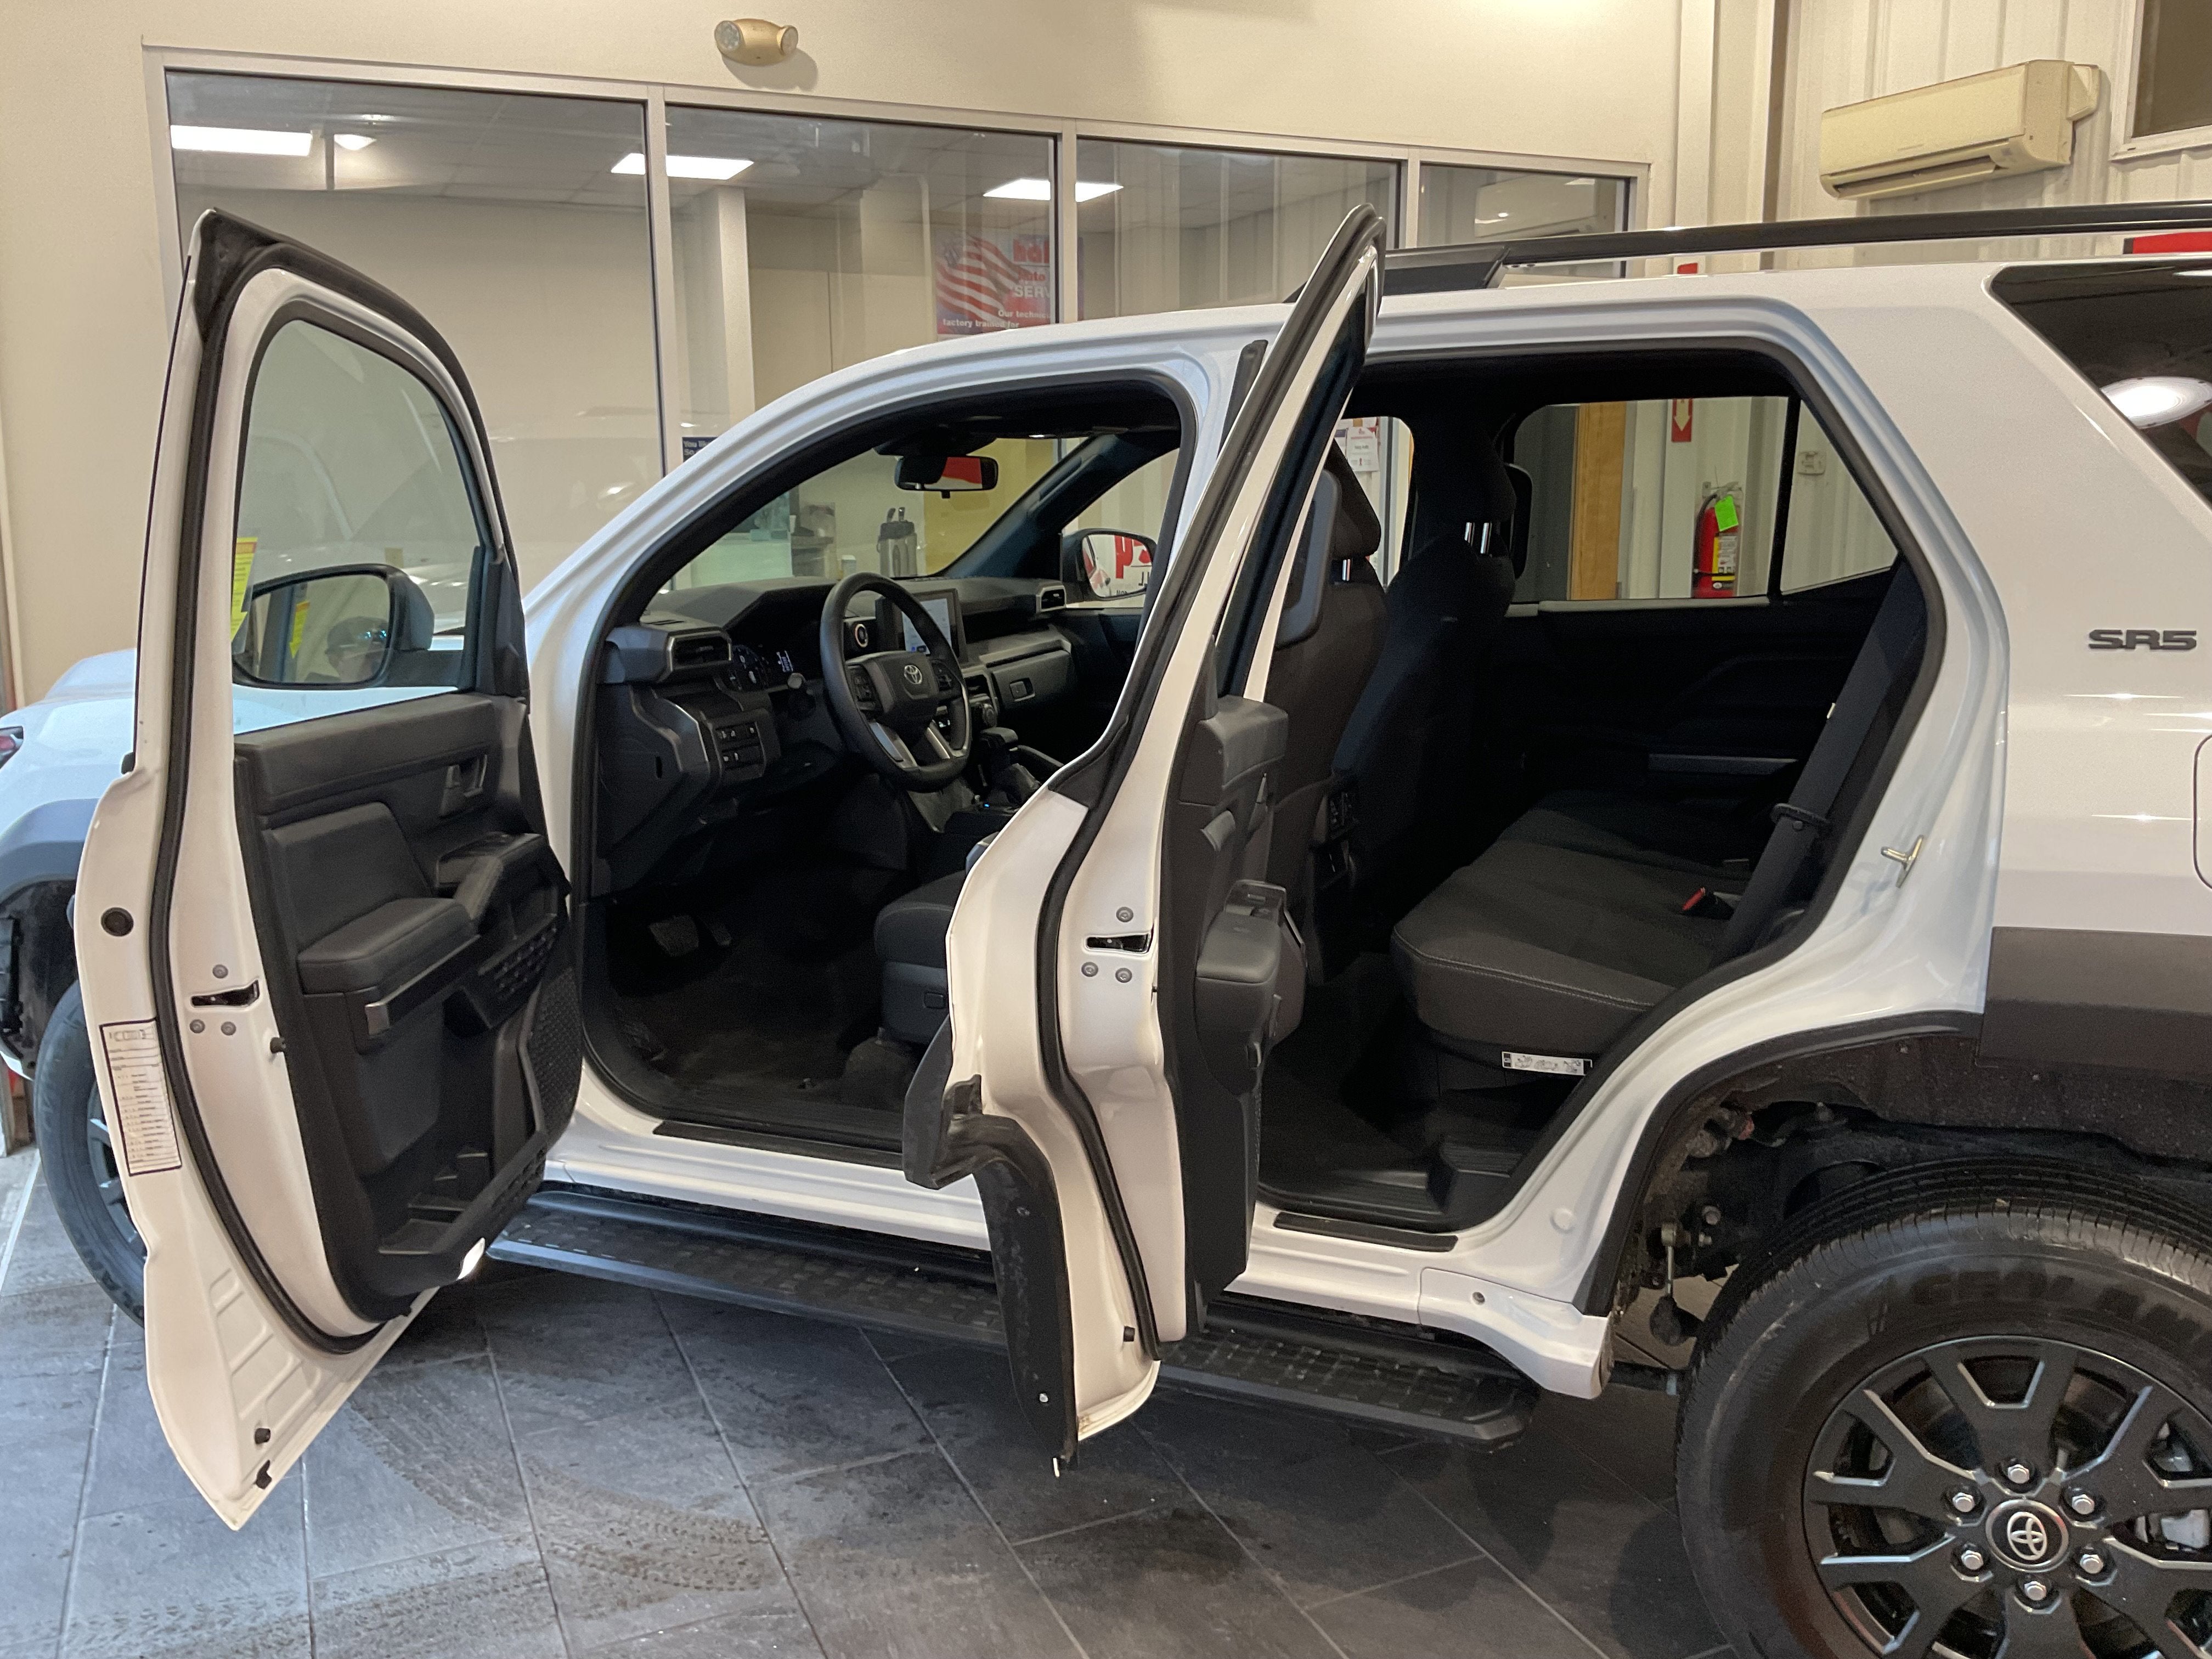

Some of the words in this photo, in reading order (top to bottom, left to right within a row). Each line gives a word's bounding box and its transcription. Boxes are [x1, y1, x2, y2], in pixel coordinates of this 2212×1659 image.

[998, 309, 1013, 318] Our
[943, 318, 973, 328] factory
[975, 320, 1006, 328] trained
[2089, 629, 2197, 650] SR5
